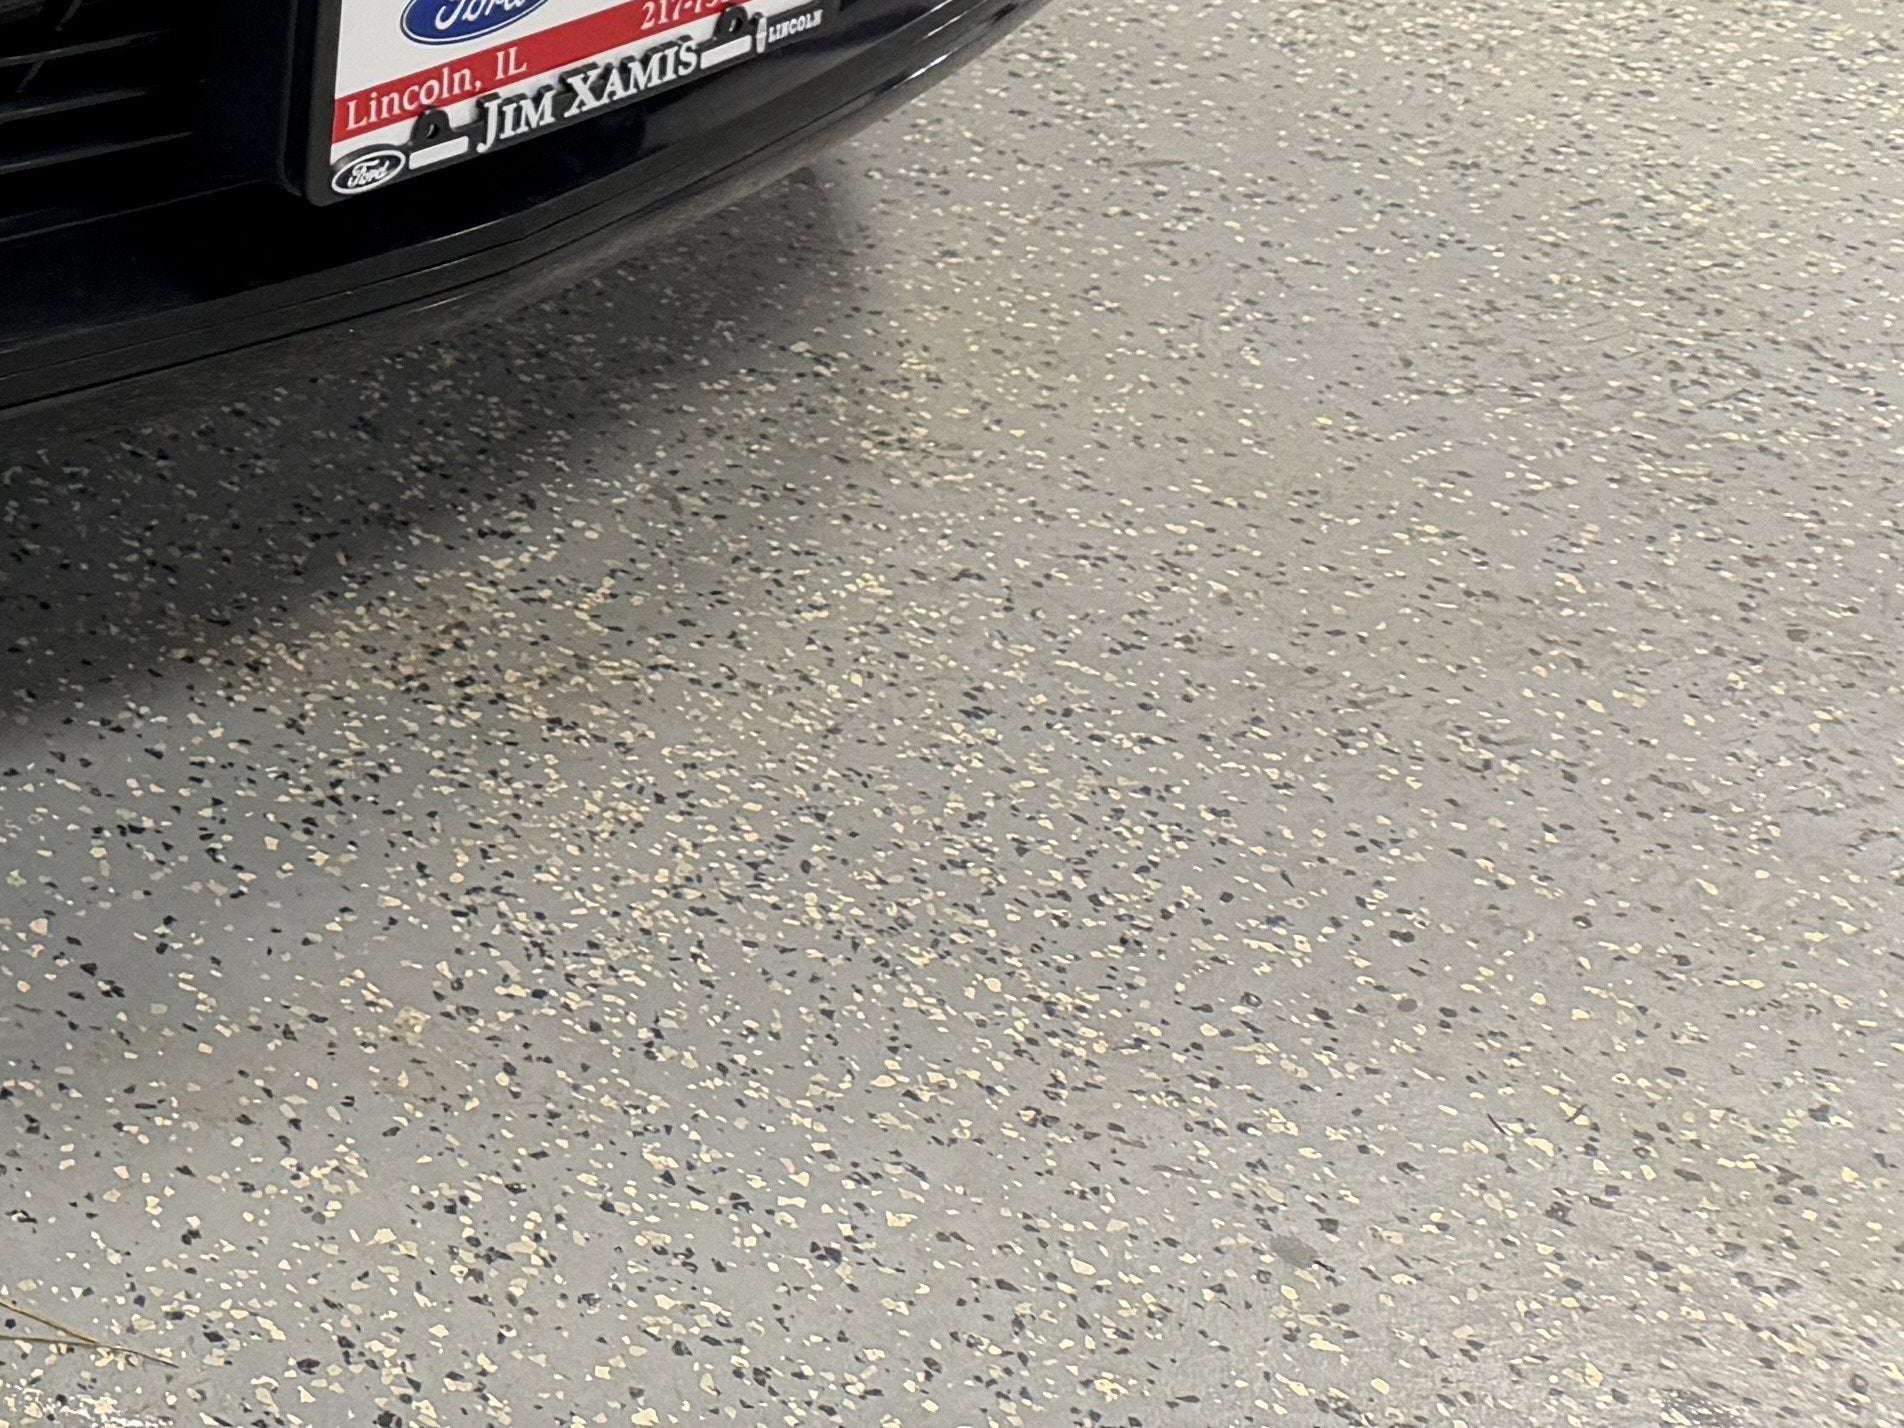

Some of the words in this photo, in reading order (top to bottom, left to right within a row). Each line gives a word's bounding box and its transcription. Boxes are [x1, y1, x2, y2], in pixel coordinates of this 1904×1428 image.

[768, 10, 823, 42] LINCOLN
[347, 67, 481, 131] Lincoln,
[495, 47, 527, 81] IL
[477, 90, 557, 153] JIM
[564, 40, 697, 118] XAMIS
[347, 159, 391, 188] Ford
